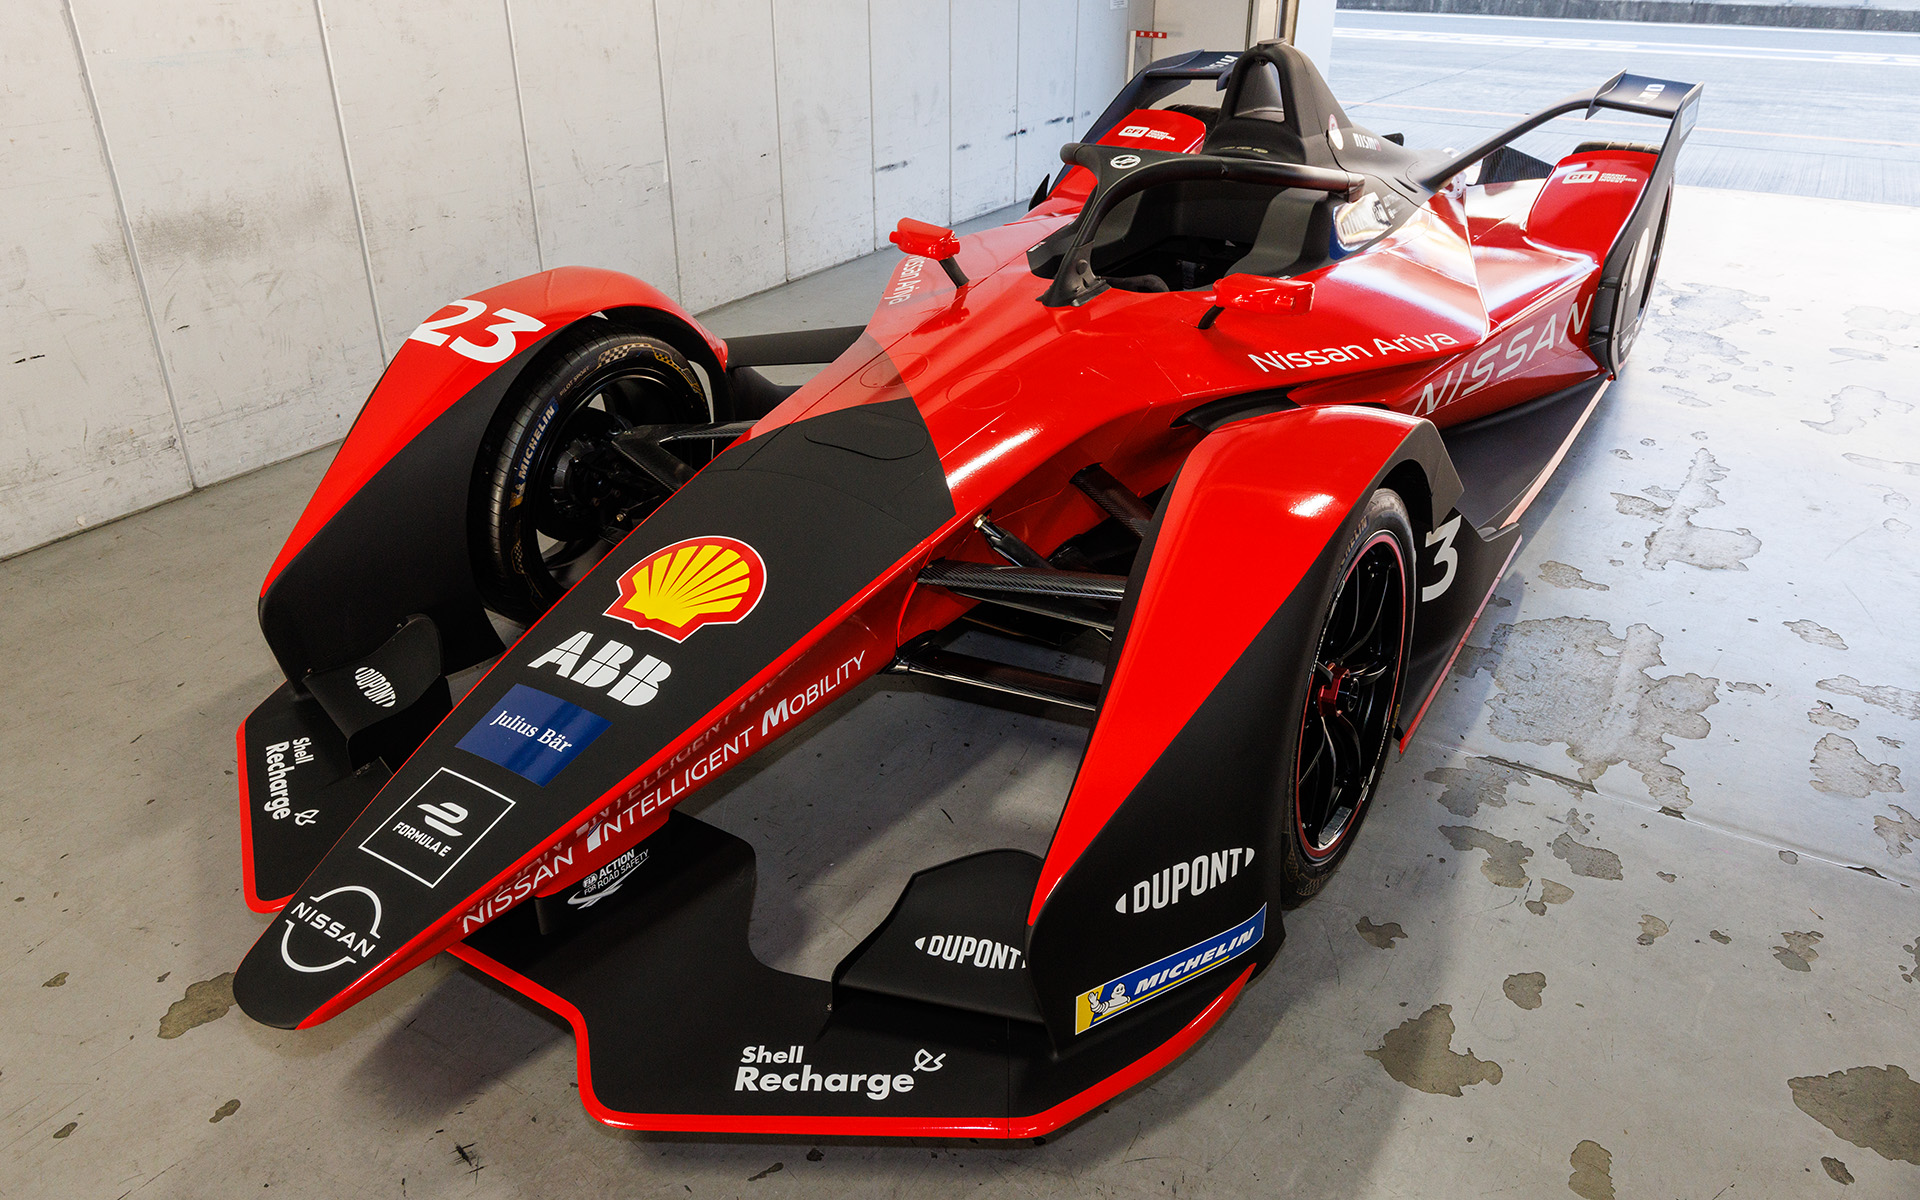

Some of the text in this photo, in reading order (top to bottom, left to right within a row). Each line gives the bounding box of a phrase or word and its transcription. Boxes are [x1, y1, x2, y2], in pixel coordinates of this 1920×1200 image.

[409, 299, 546, 363] 23
[1247, 331, 1458, 373] Nissan Ariya
[1412, 293, 1593, 415] NISSAN
[518, 405, 555, 481] MICHELIN
[355, 668, 396, 705] DUPONT
[528, 631, 672, 706] ABB
[293, 737, 314, 765] Shell
[490, 711, 573, 753] Julius Bär
[264, 741, 295, 820] Recharge
[393, 821, 452, 857] FORMULA E
[463, 847, 574, 933] NISSAN
[586, 726, 754, 853] INTELLIGENT
[584, 849, 649, 895] FOR ROAD SAFETY
[599, 849, 635, 880] ACTION
[1133, 848, 1243, 913] DUPONT
[291, 902, 375, 958] NISSAN
[928, 935, 1021, 970] DUPONT
[1135, 926, 1256, 994] MICHELIN
[741, 1046, 803, 1064] Shell
[735, 1064, 914, 1099] Recharge
